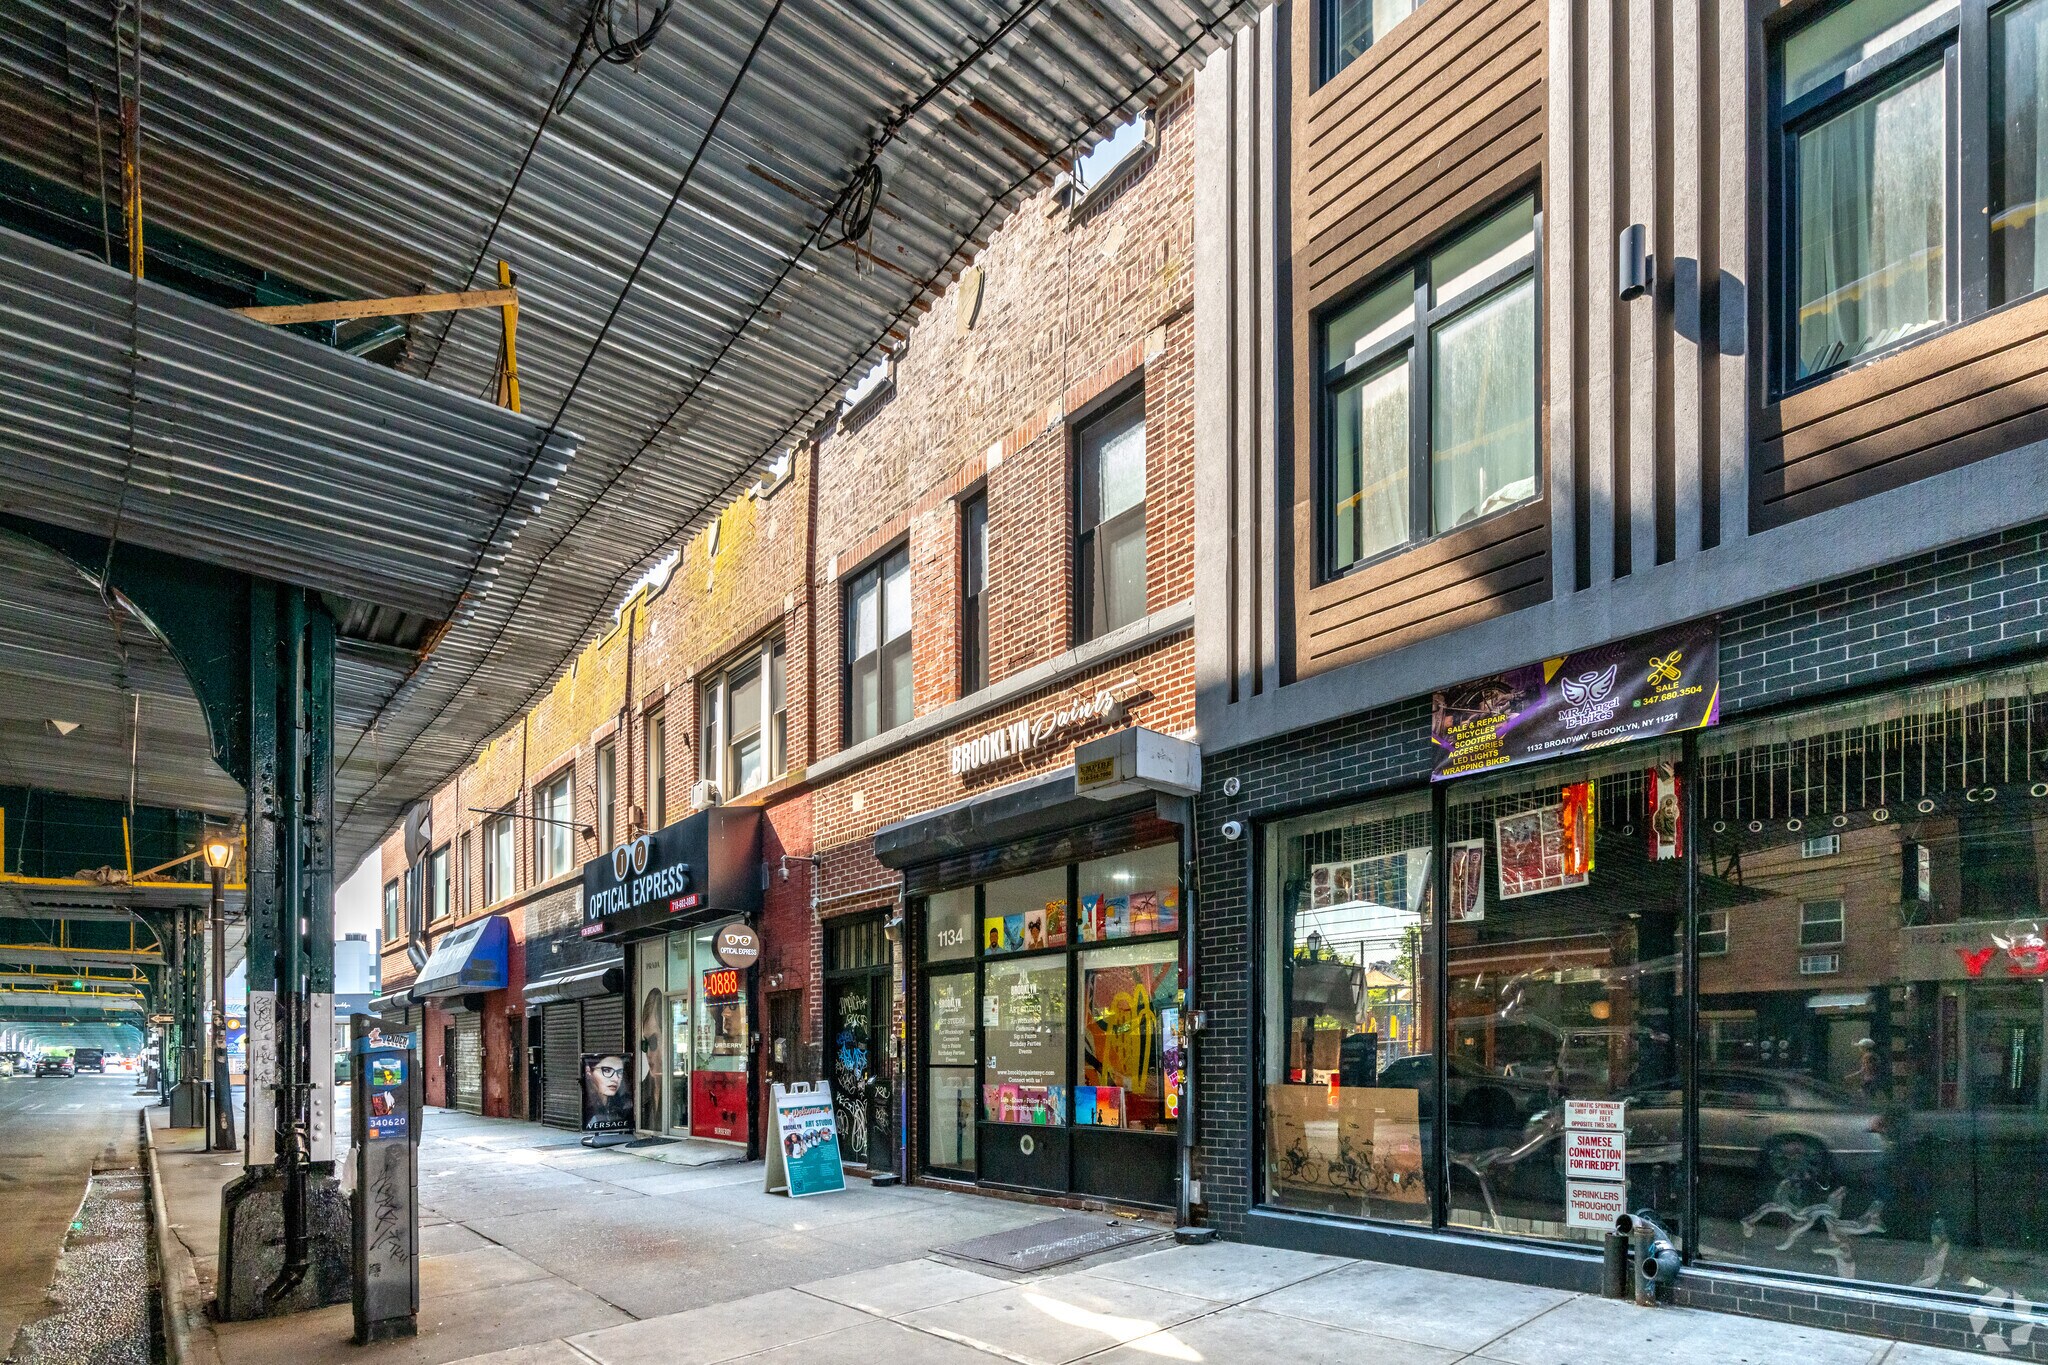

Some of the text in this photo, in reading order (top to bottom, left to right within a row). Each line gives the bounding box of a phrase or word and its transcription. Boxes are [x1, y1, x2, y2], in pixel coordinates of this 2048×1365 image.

[1656, 682, 1679, 693] SALE
[1643, 685, 1703, 706] 347.680.3504
[1559, 697, 1620, 722] MR. Angel
[1447, 724, 1467, 735] SALE
[1477, 714, 1507, 727] REPAIR
[1566, 709, 1614, 729] E-bikes
[952, 690, 1115, 775] BROOKLYN Paints
[1456, 726, 1496, 740] BICYCLES
[1527, 712, 1679, 753] 1132 BROADWAY, BROOKLYN, NY 11221
[1455, 733, 1497, 749] SCOOTERS
[1448, 740, 1504, 759] ACCESSORIES
[1453, 749, 1499, 766] LED LIGHTS
[1442, 755, 1511, 776] WRAPPING BIKES
[589, 863, 687, 920] OPTICAL EXPRESS
[937, 928, 964, 947] 1134
[720, 947, 738, 955] OPTICAL
[370, 1117, 406, 1127] 340620
[586, 1120, 629, 1129] VERSACE
[805, 1118, 833, 1128] ART STUDIO
[1577, 1136, 1612, 1147] SIAMESE
[1569, 1147, 1622, 1159] CONNECTION
[1570, 1159, 1621, 1171] FOR FIRE DEPT.
[1572, 1190, 1619, 1200] SPRINKLERS
[1571, 1200, 1622, 1212] THROUGHOUT
[1578, 1211, 1614, 1222] BUILDING
